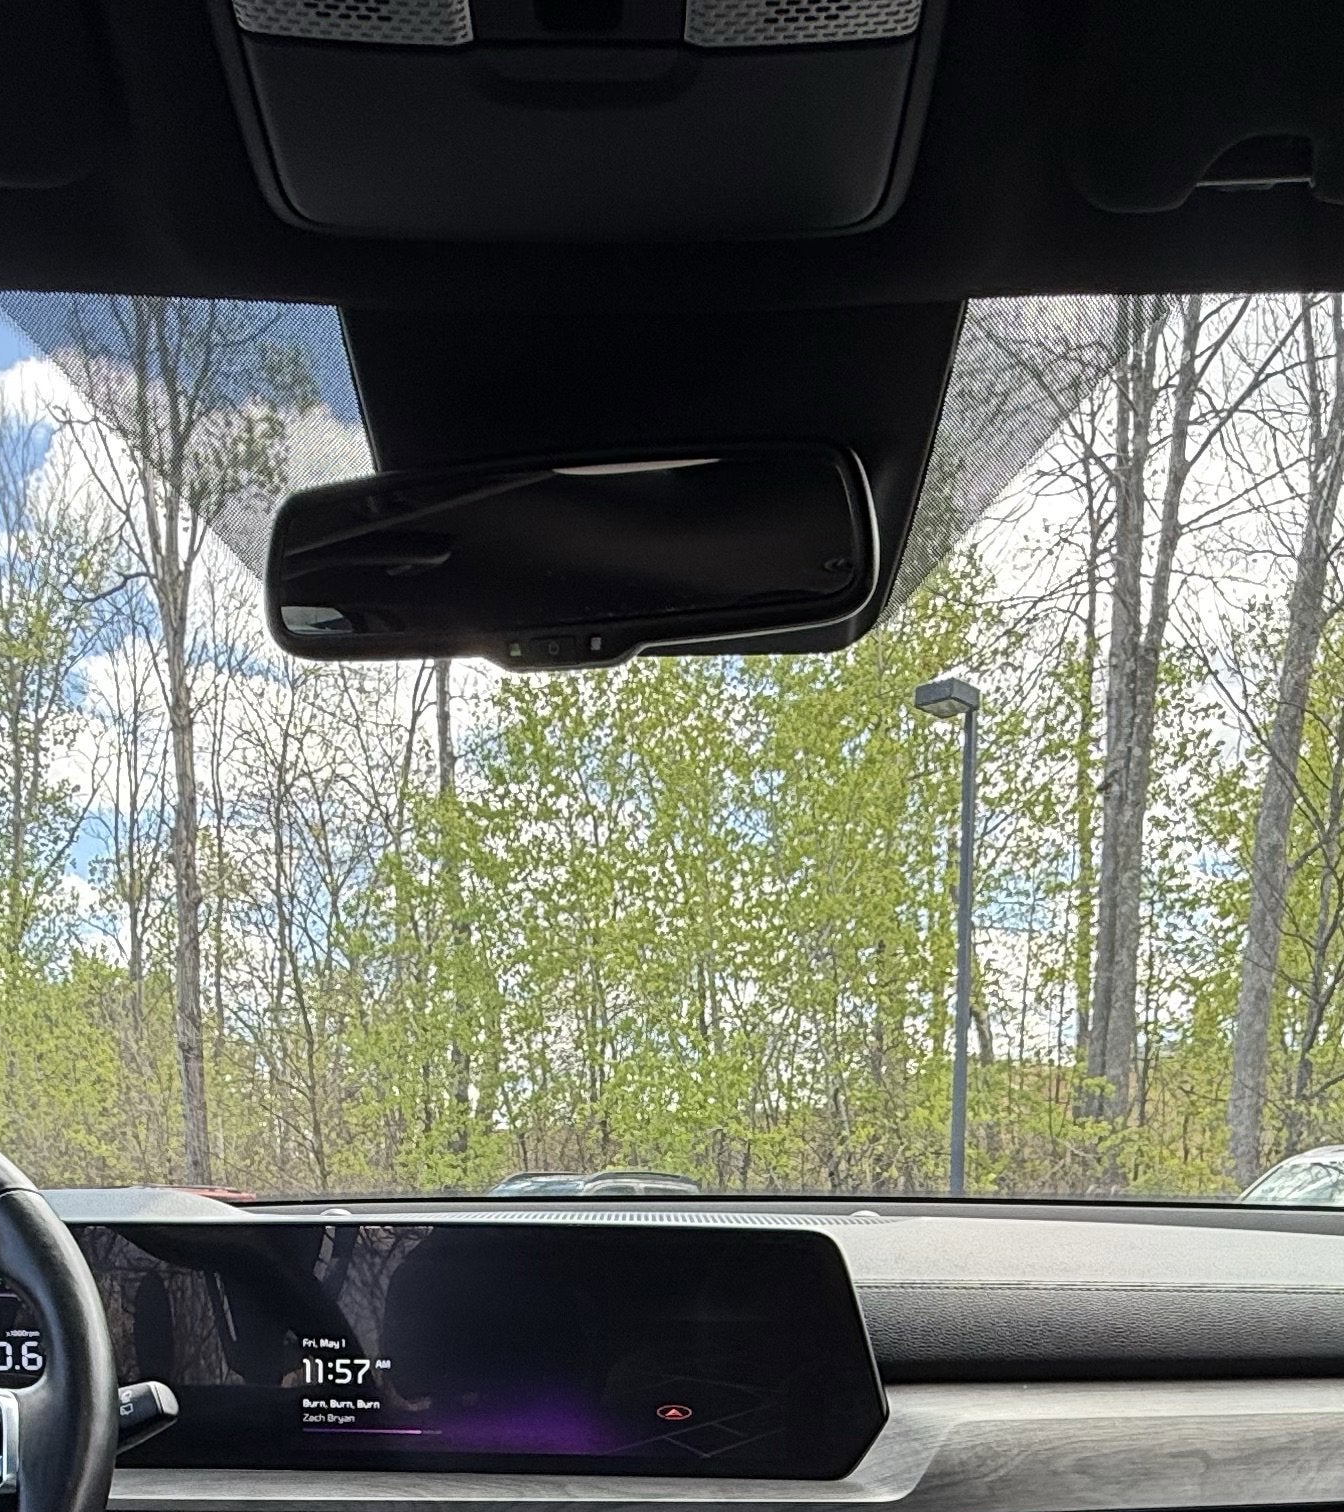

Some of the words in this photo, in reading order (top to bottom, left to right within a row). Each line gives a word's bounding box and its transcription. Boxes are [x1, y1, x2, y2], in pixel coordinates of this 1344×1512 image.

[319, 1339, 340, 1349] May
[303, 1358, 370, 1384] 11:57
[375, 1359, 392, 1369] AM
[302, 1399, 328, 1409] Burn,
[330, 1399, 355, 1410] Burn,
[357, 1400, 380, 1409] Burn
[303, 1413, 325, 1422] Zach
[327, 1414, 355, 1424] Bryan
